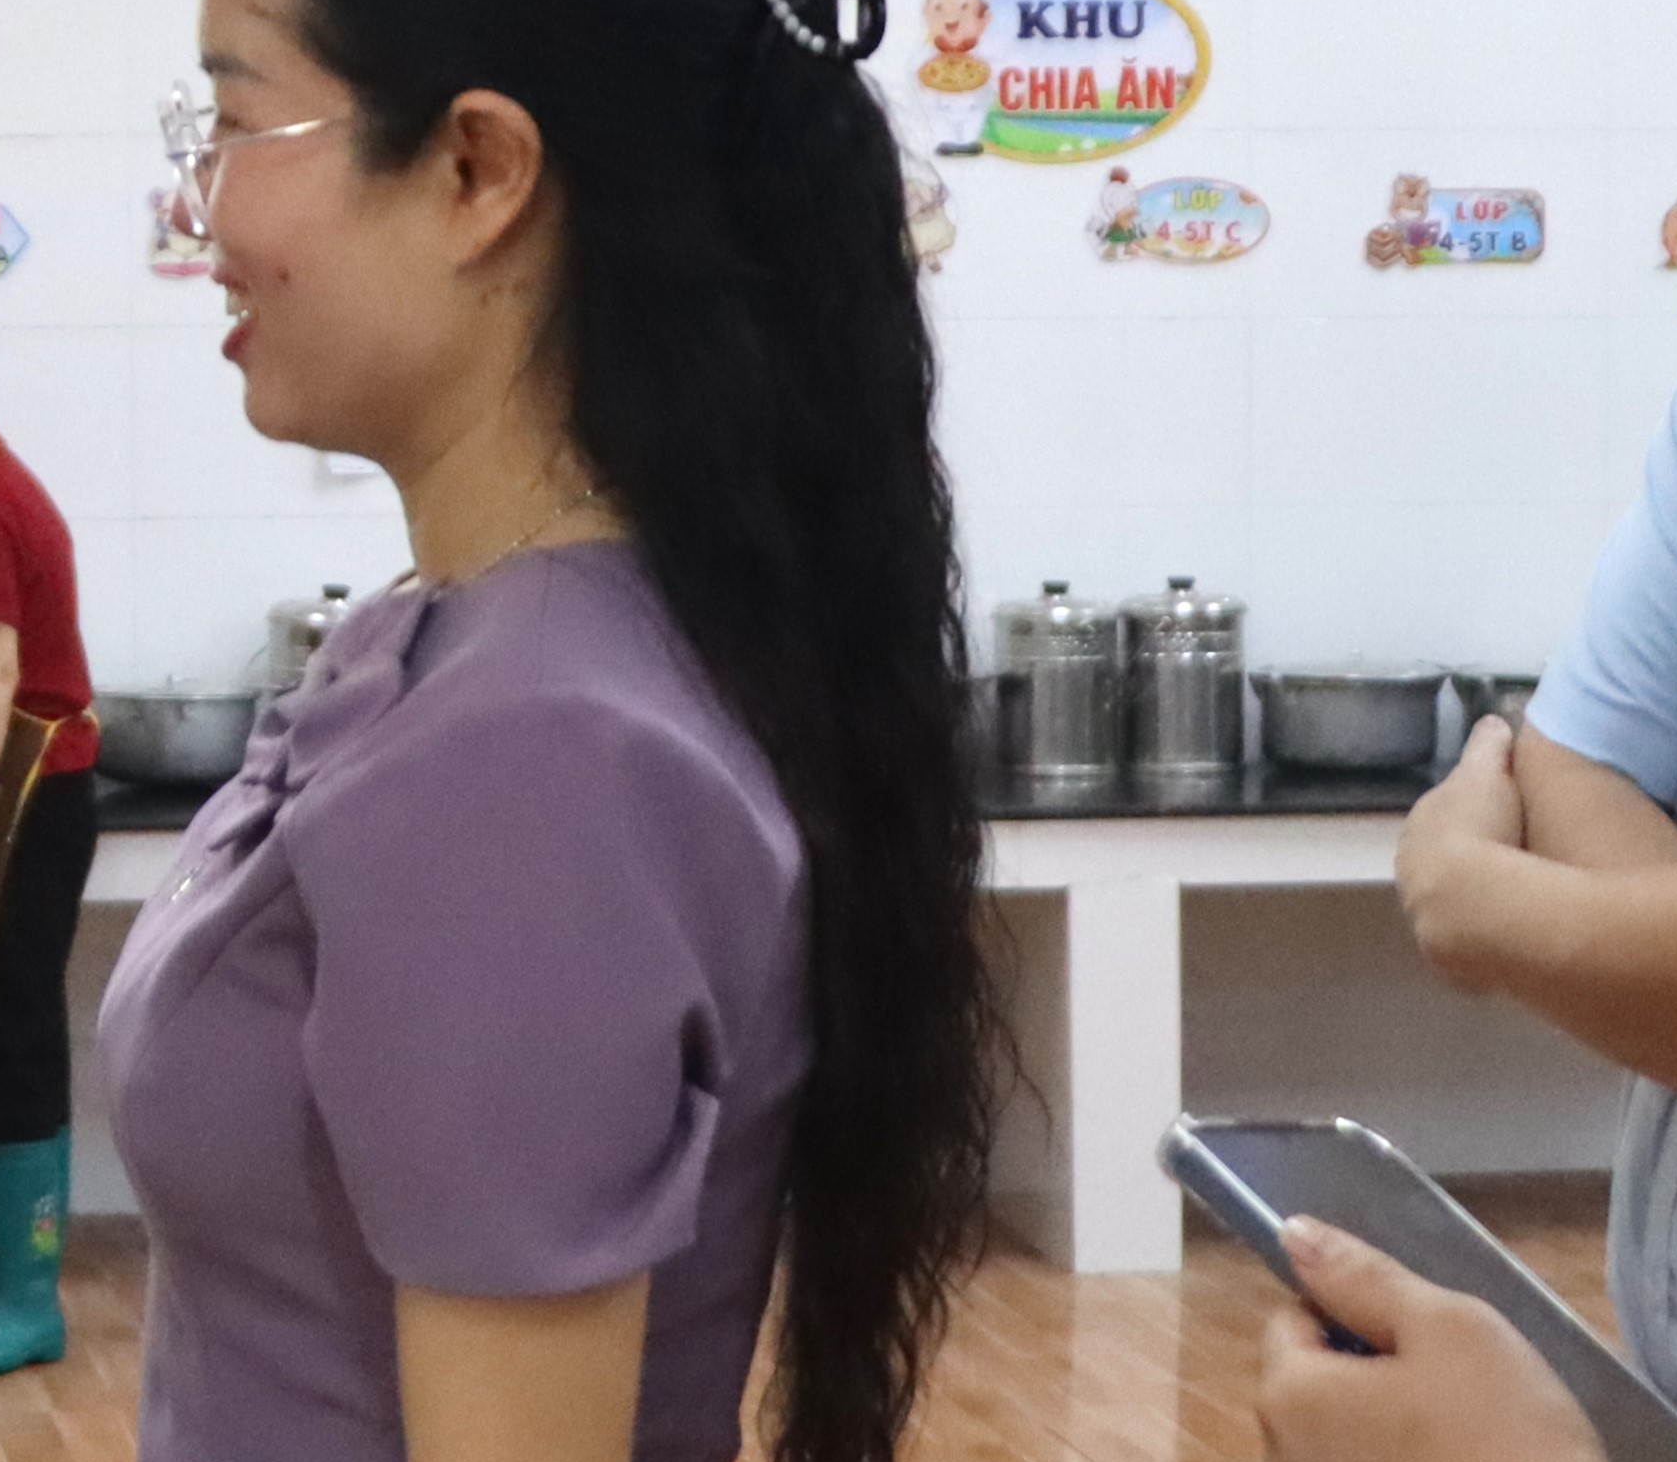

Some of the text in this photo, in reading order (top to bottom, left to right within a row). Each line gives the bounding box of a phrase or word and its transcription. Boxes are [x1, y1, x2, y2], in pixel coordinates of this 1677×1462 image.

[1016, 0, 1148, 40] KHU
[998, 55, 1177, 111] CHIA ĂN
[1172, 183, 1224, 213] LỚP
[1455, 196, 1509, 221] LỚP
[1225, 220, 1243, 243] C
[1511, 230, 1528, 252] B
